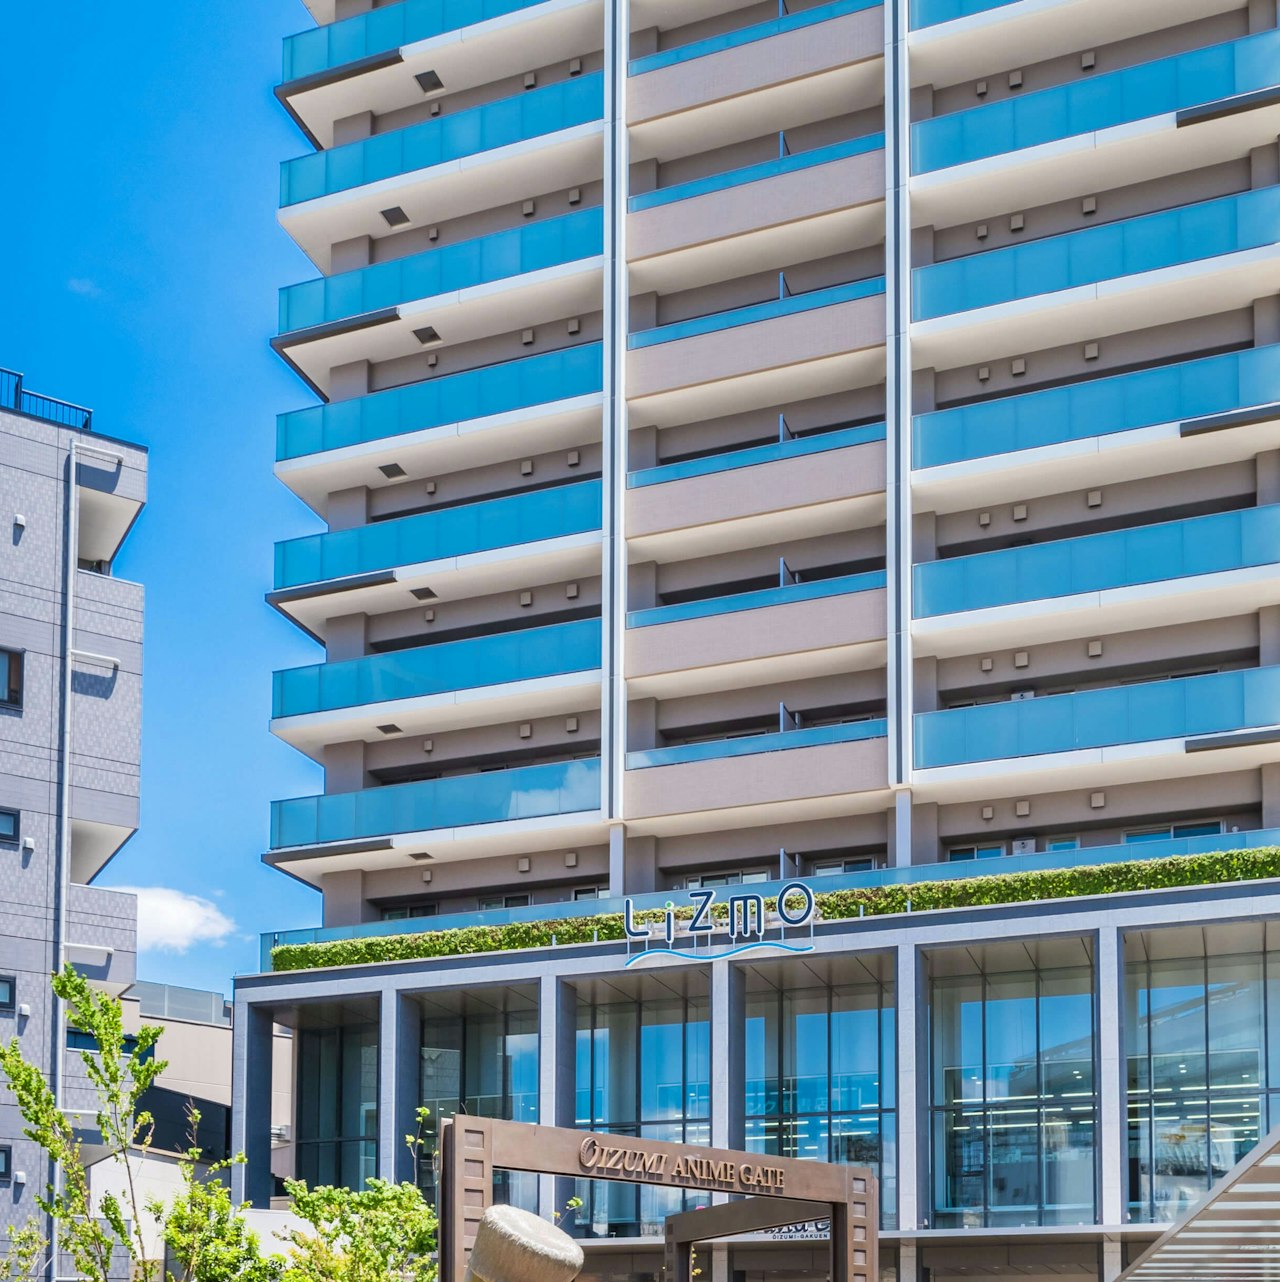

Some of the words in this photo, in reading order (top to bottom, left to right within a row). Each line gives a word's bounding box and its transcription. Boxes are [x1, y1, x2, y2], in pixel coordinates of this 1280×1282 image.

[579, 1136, 669, 1176] OIZUMI
[671, 1155, 736, 1183] ANIME
[739, 1164, 785, 1188] GATE
